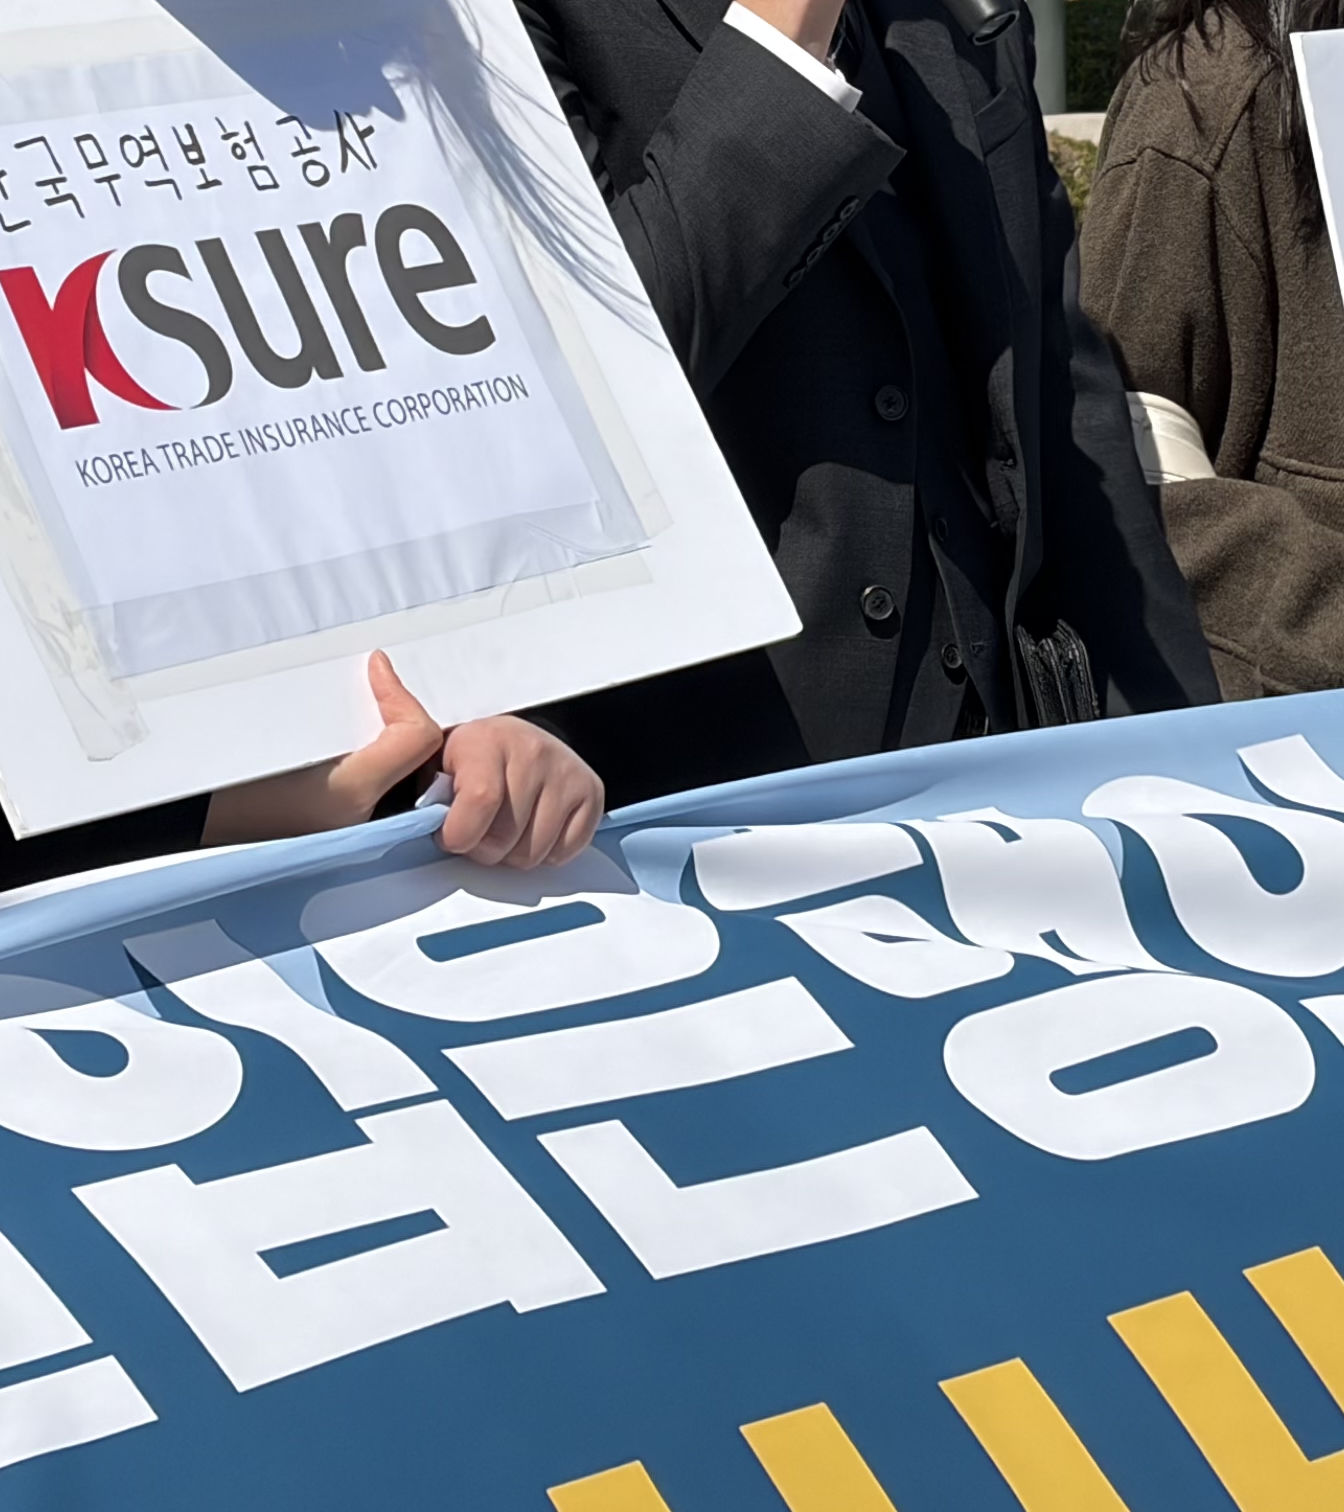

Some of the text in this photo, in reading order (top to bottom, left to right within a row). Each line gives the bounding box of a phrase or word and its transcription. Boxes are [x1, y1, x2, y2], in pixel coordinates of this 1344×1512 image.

[75, 374, 530, 487] KOREA TRADE INSURANCE CORPORATION
